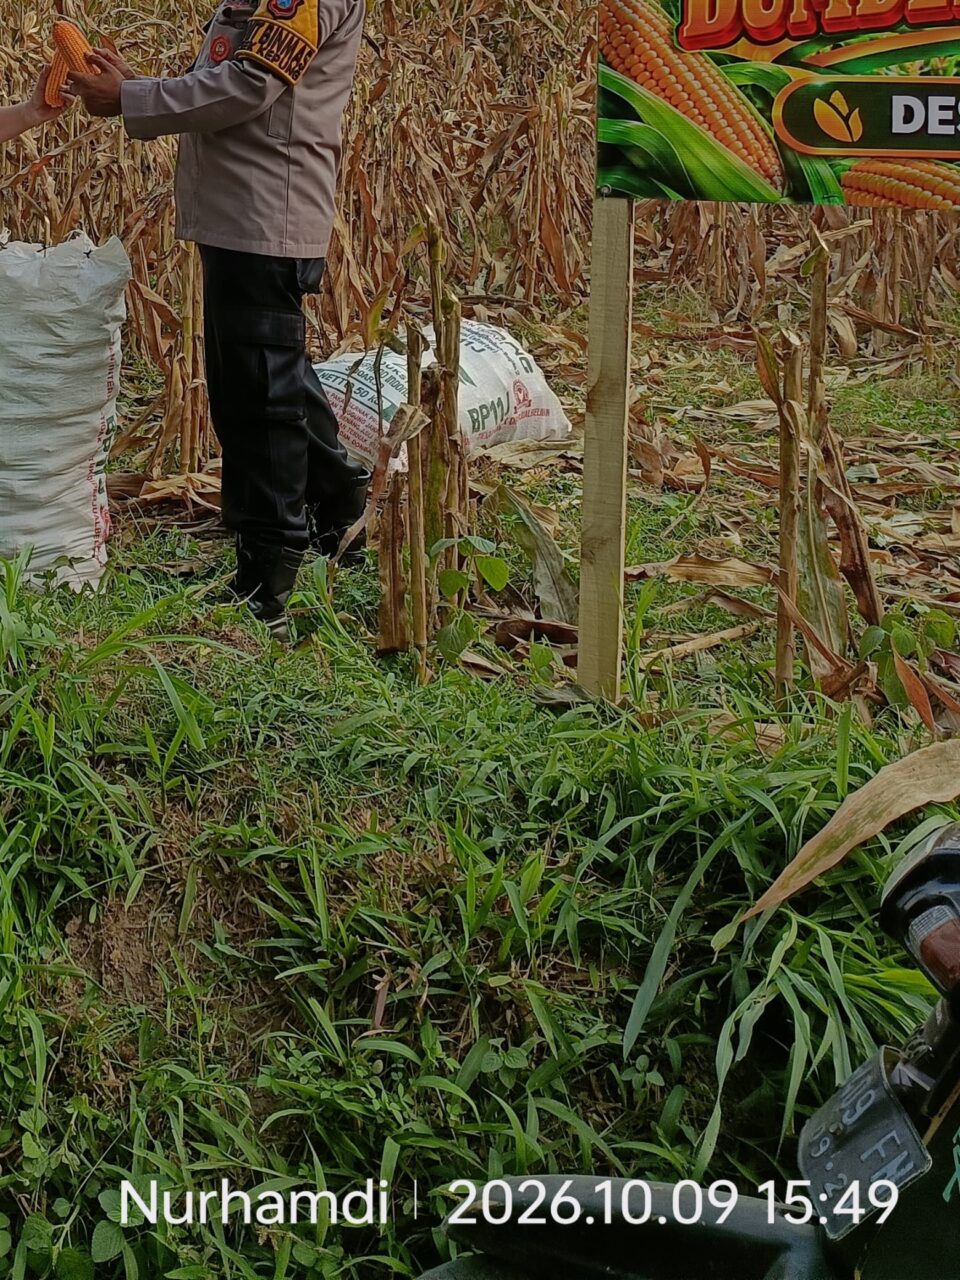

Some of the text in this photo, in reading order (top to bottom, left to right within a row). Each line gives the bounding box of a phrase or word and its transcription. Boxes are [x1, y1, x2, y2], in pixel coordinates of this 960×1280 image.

[256, 47, 300, 81] KEPUNG
[259, 22, 314, 72] BINMAS
[892, 95, 960, 135] DE
[354, 386, 370, 398] 50
